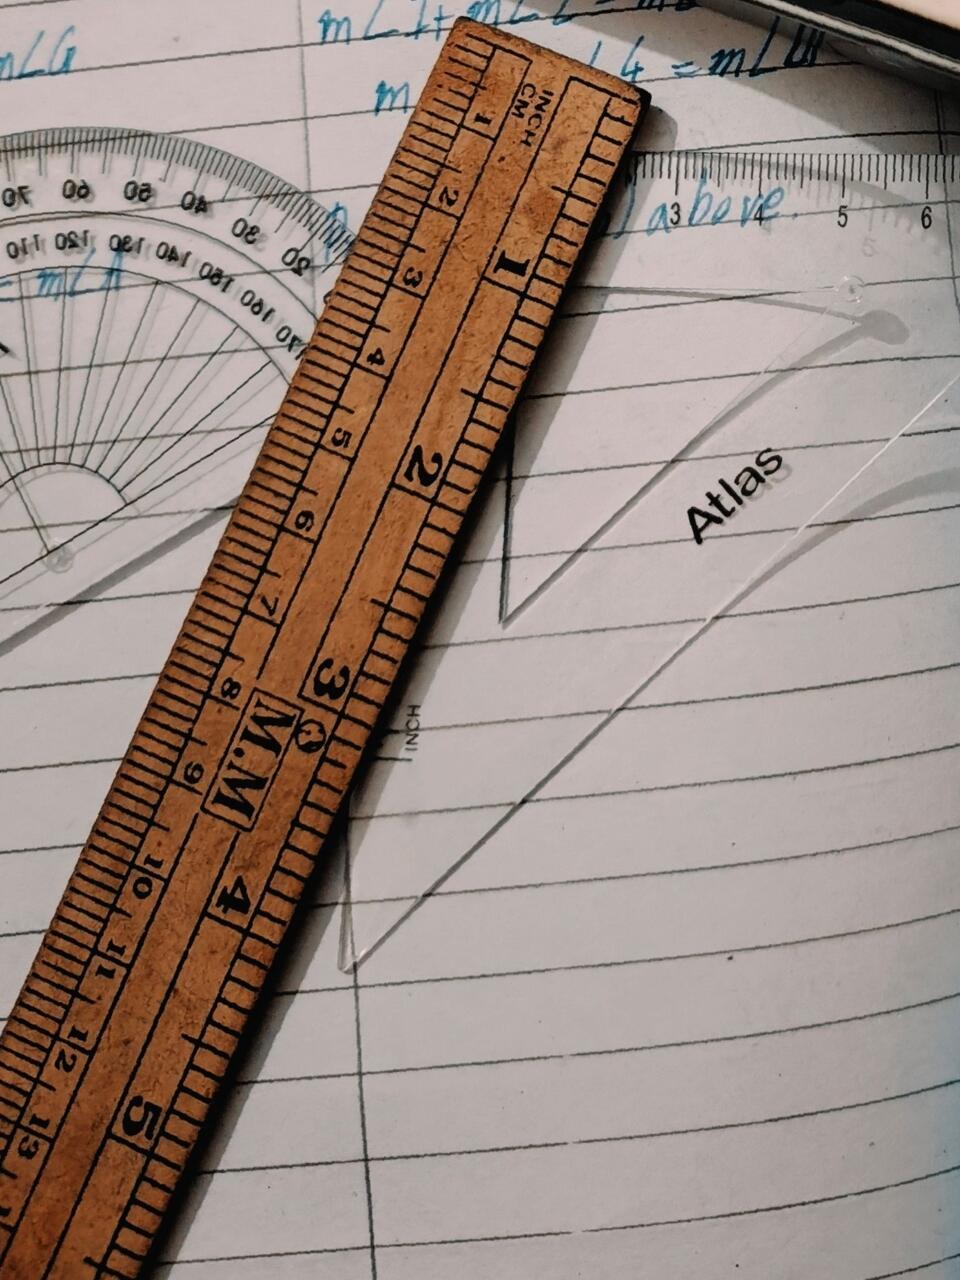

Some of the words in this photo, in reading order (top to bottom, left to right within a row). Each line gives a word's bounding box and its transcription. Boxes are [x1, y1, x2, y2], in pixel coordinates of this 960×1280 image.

[519, 83, 536, 119] CM
[519, 89, 554, 147] INCH
[836, 205, 849, 227] 5
[921, 206, 934, 229] 6
[492, 249, 531, 277] 1
[403, 444, 443, 488] 2
[687, 448, 783, 545] Atlas
[313, 657, 350, 701] 3
[405, 704, 421, 752] INCH
[216, 876, 251, 916] 4
[123, 1095, 163, 1141] 5
